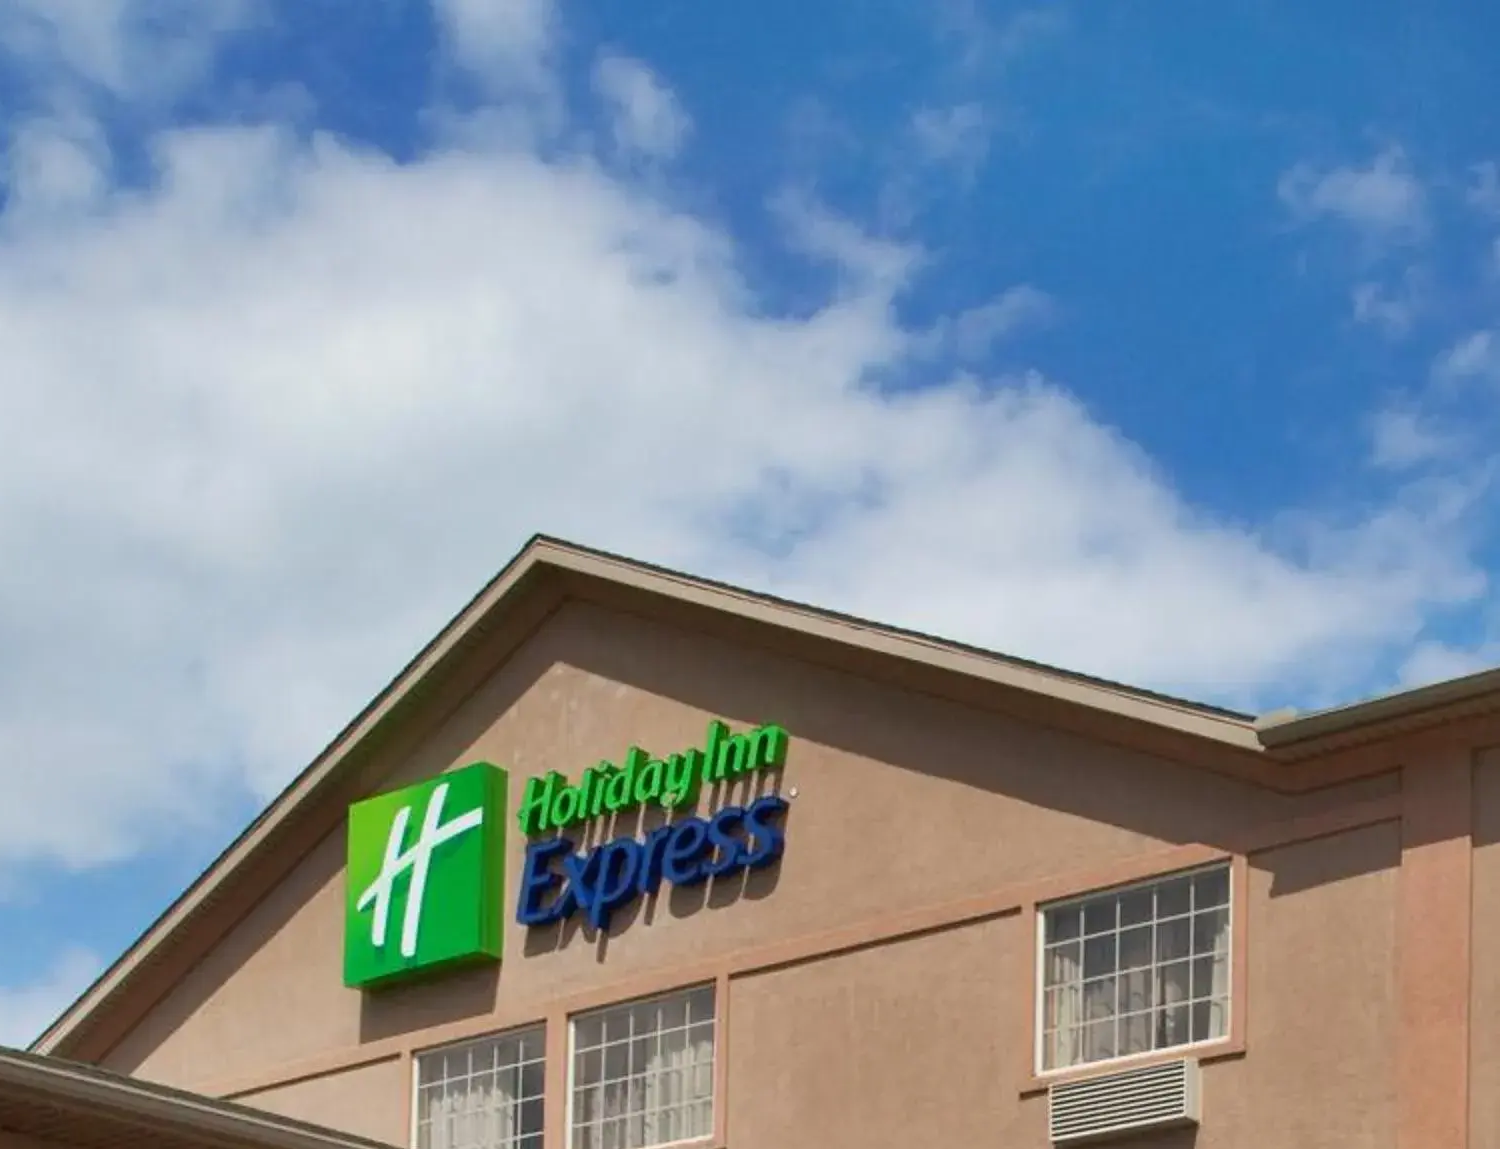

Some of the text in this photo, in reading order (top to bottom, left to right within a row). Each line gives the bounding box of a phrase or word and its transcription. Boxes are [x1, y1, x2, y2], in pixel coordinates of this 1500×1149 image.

[517, 719, 789, 836] Holiday Inn
[516, 795, 790, 930] Express
